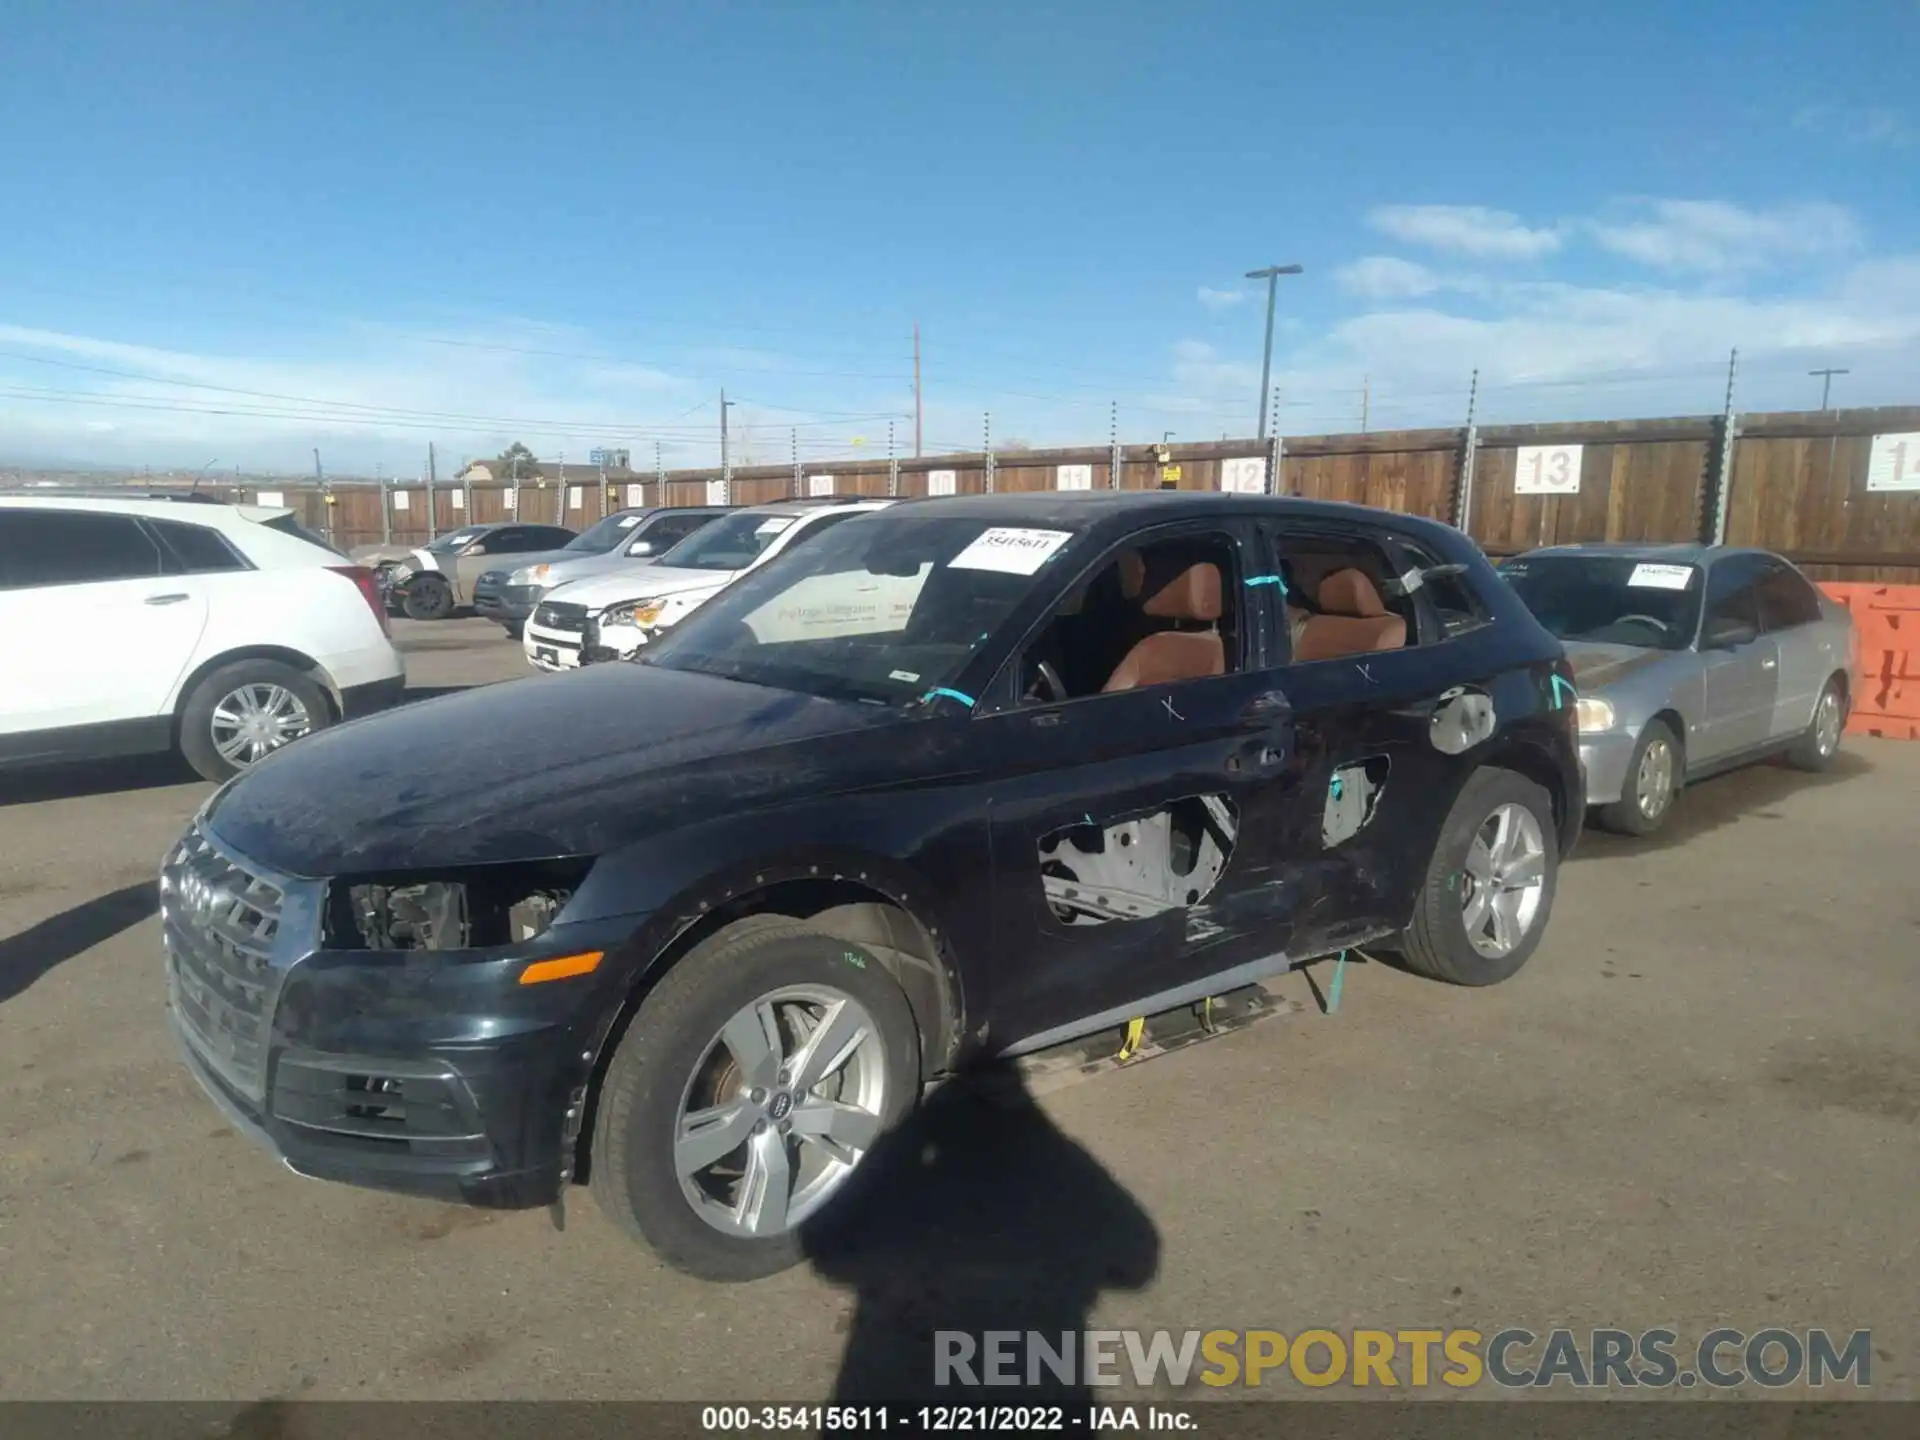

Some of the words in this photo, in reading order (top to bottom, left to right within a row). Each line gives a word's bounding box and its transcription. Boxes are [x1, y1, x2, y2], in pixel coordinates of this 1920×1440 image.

[1230, 462, 1259, 490] 12
[1528, 450, 1571, 487] 13
[1886, 441, 1920, 481] 1
